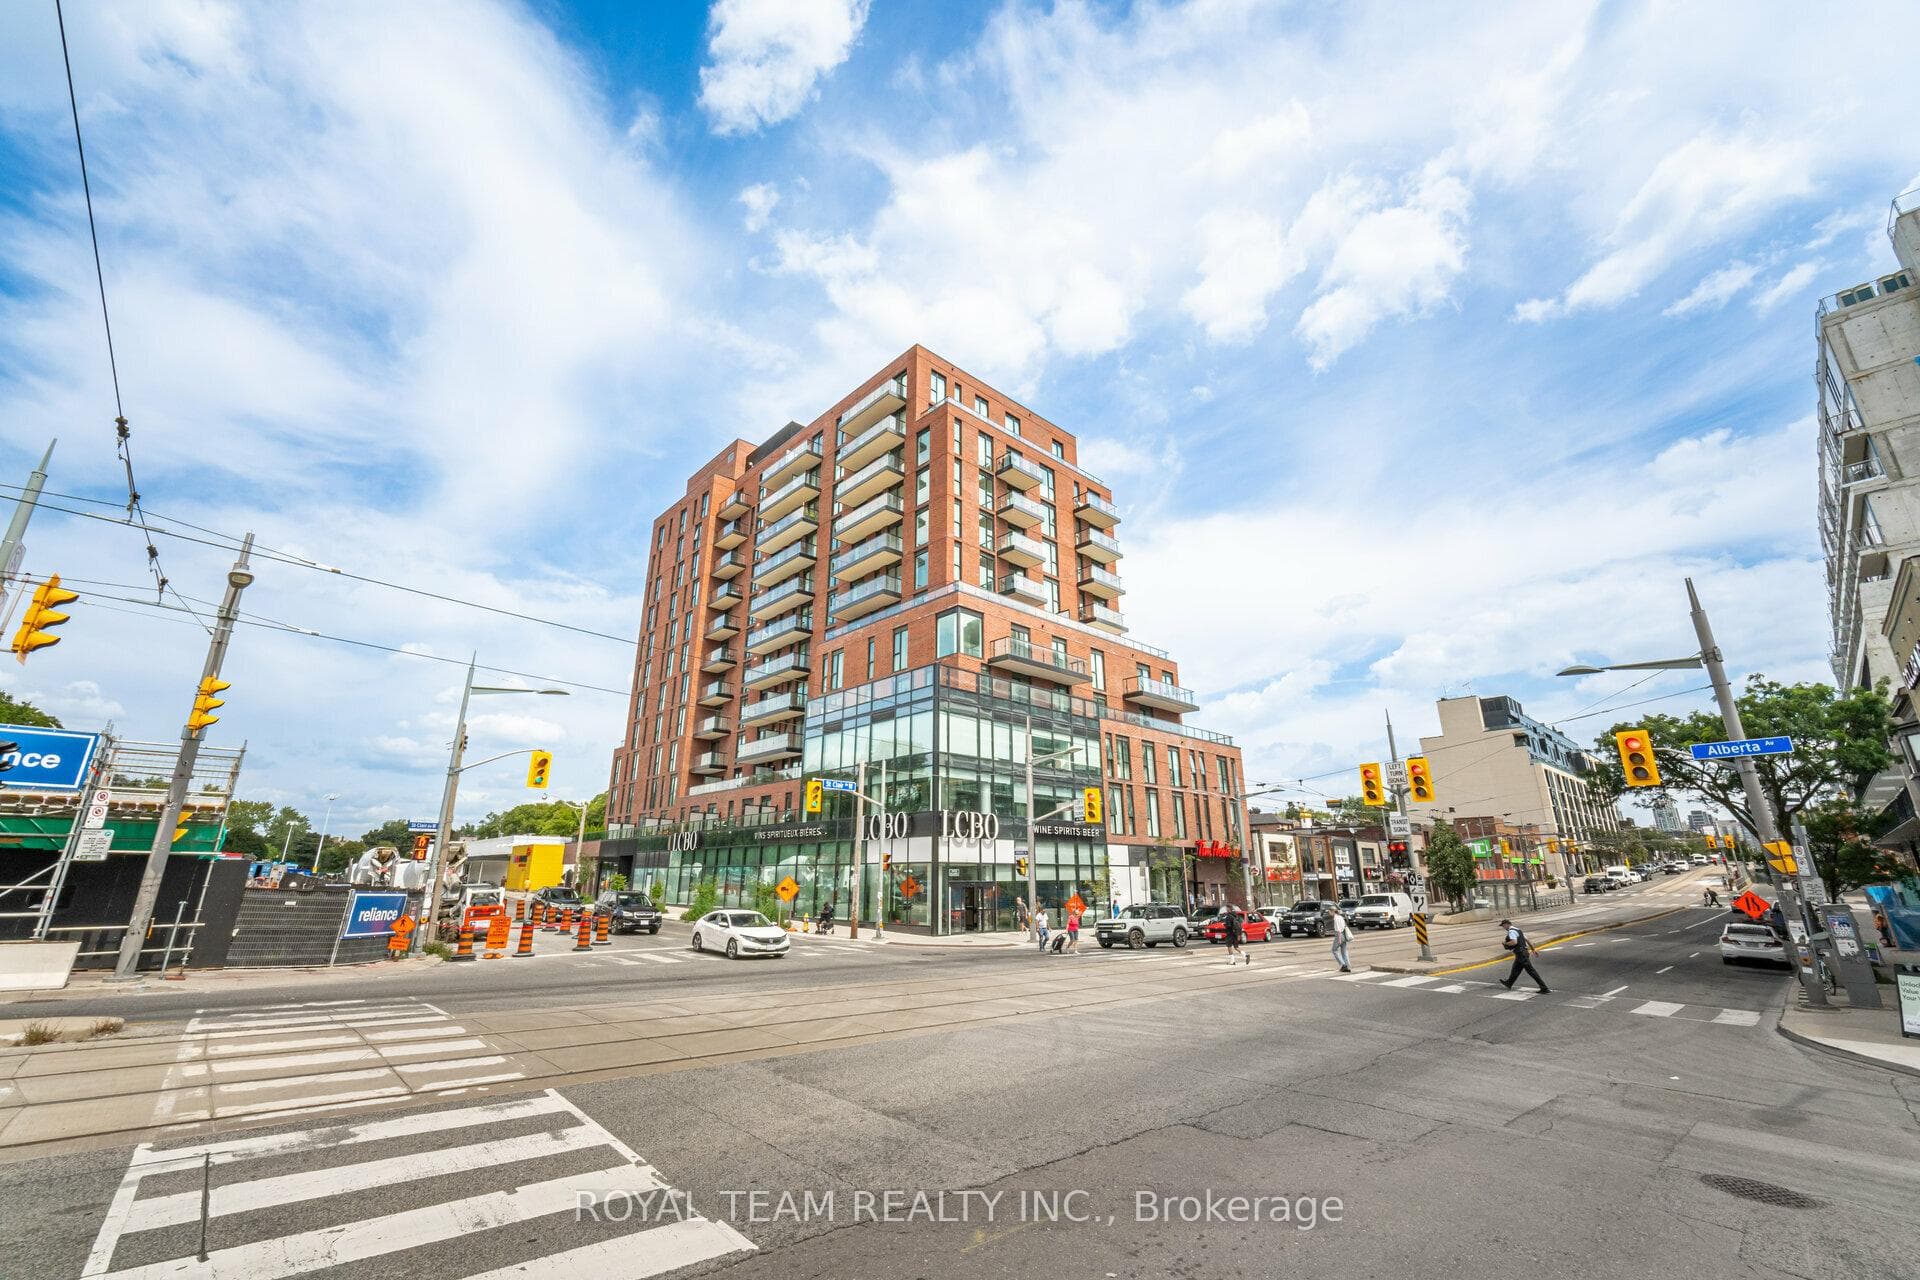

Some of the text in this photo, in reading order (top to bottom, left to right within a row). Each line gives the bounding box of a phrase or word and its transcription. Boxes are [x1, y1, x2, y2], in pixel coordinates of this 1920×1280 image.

[1708, 742, 1761, 756] Alberta
[861, 811, 907, 840] LCBO
[942, 809, 999, 840] LCBO
[1391, 818, 1408, 826] TRANSIT
[1033, 825, 1100, 837] WINE SPIRITS BEER
[672, 830, 698, 851] LCBO
[358, 906, 399, 922] reliance
